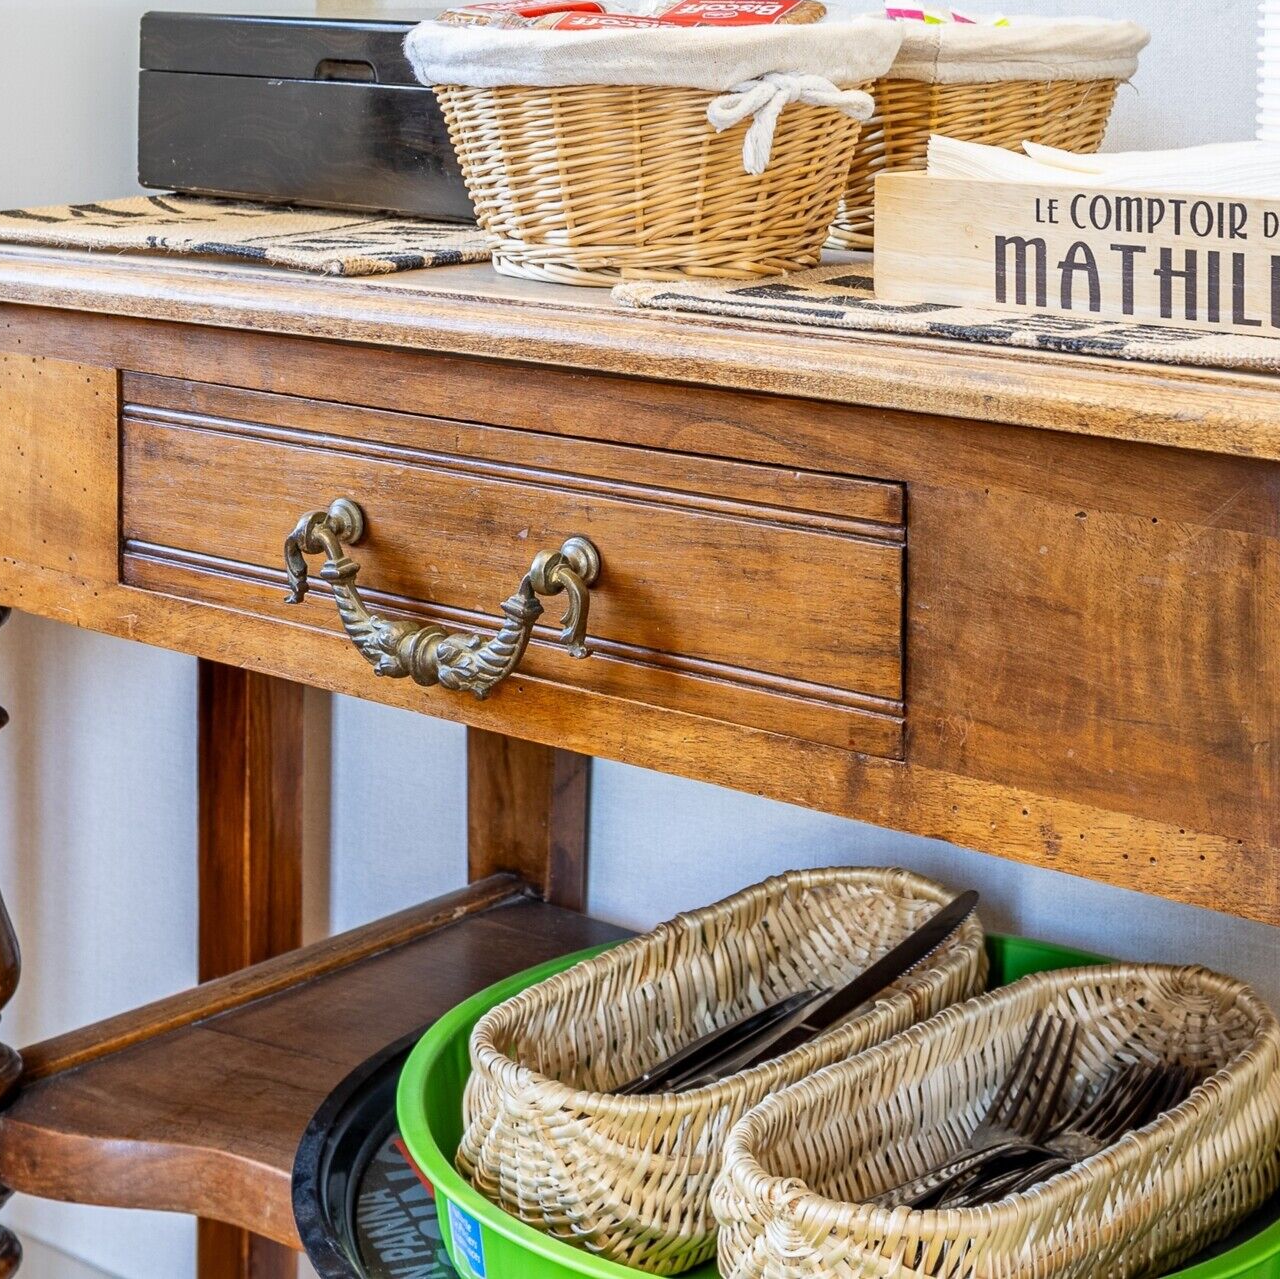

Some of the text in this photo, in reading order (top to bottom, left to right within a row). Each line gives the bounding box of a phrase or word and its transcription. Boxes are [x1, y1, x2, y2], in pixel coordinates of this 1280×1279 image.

[675, 4, 784, 16] Biscoff
[1035, 197, 1059, 224] LE
[1070, 193, 1248, 240] COMPTOIR
